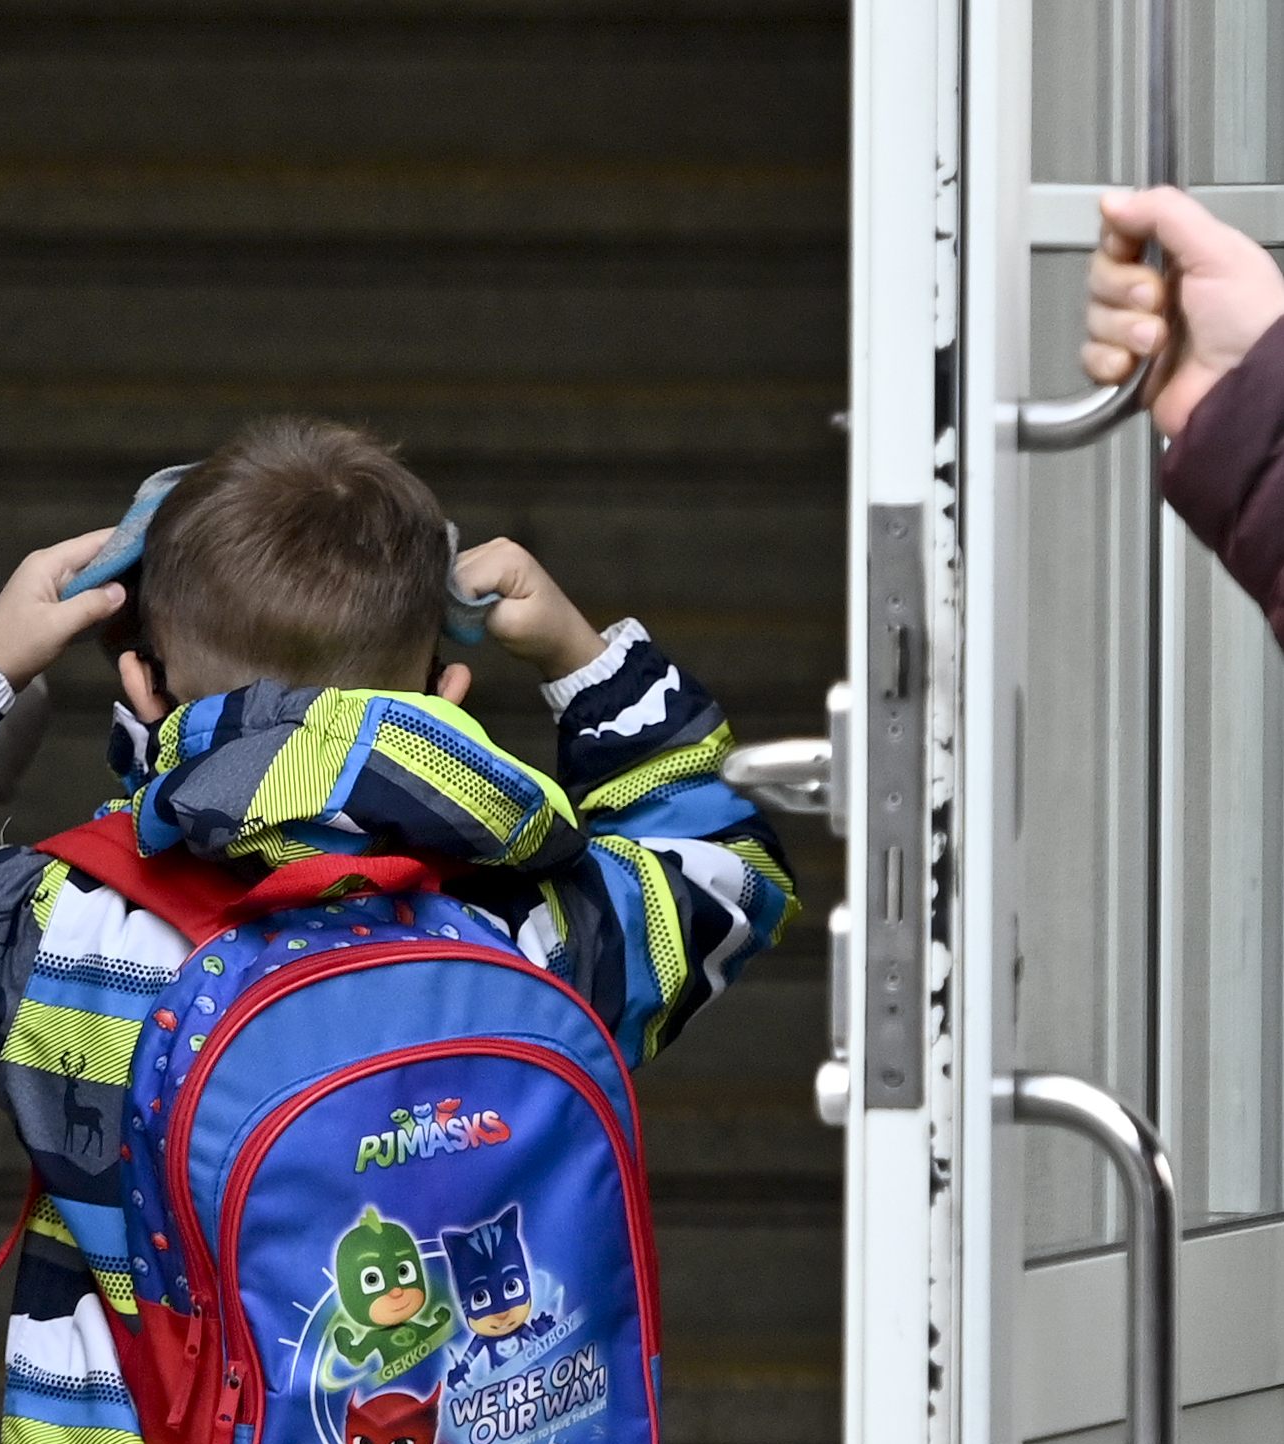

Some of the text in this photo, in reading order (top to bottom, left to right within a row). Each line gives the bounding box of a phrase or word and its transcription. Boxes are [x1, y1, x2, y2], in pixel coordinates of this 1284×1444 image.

[381, 1342, 430, 1380] GEKKO
[524, 1315, 573, 1362] CATBOY
[451, 1342, 597, 1427] WE'RE ON
[542, 1366, 607, 1421] WAY!
